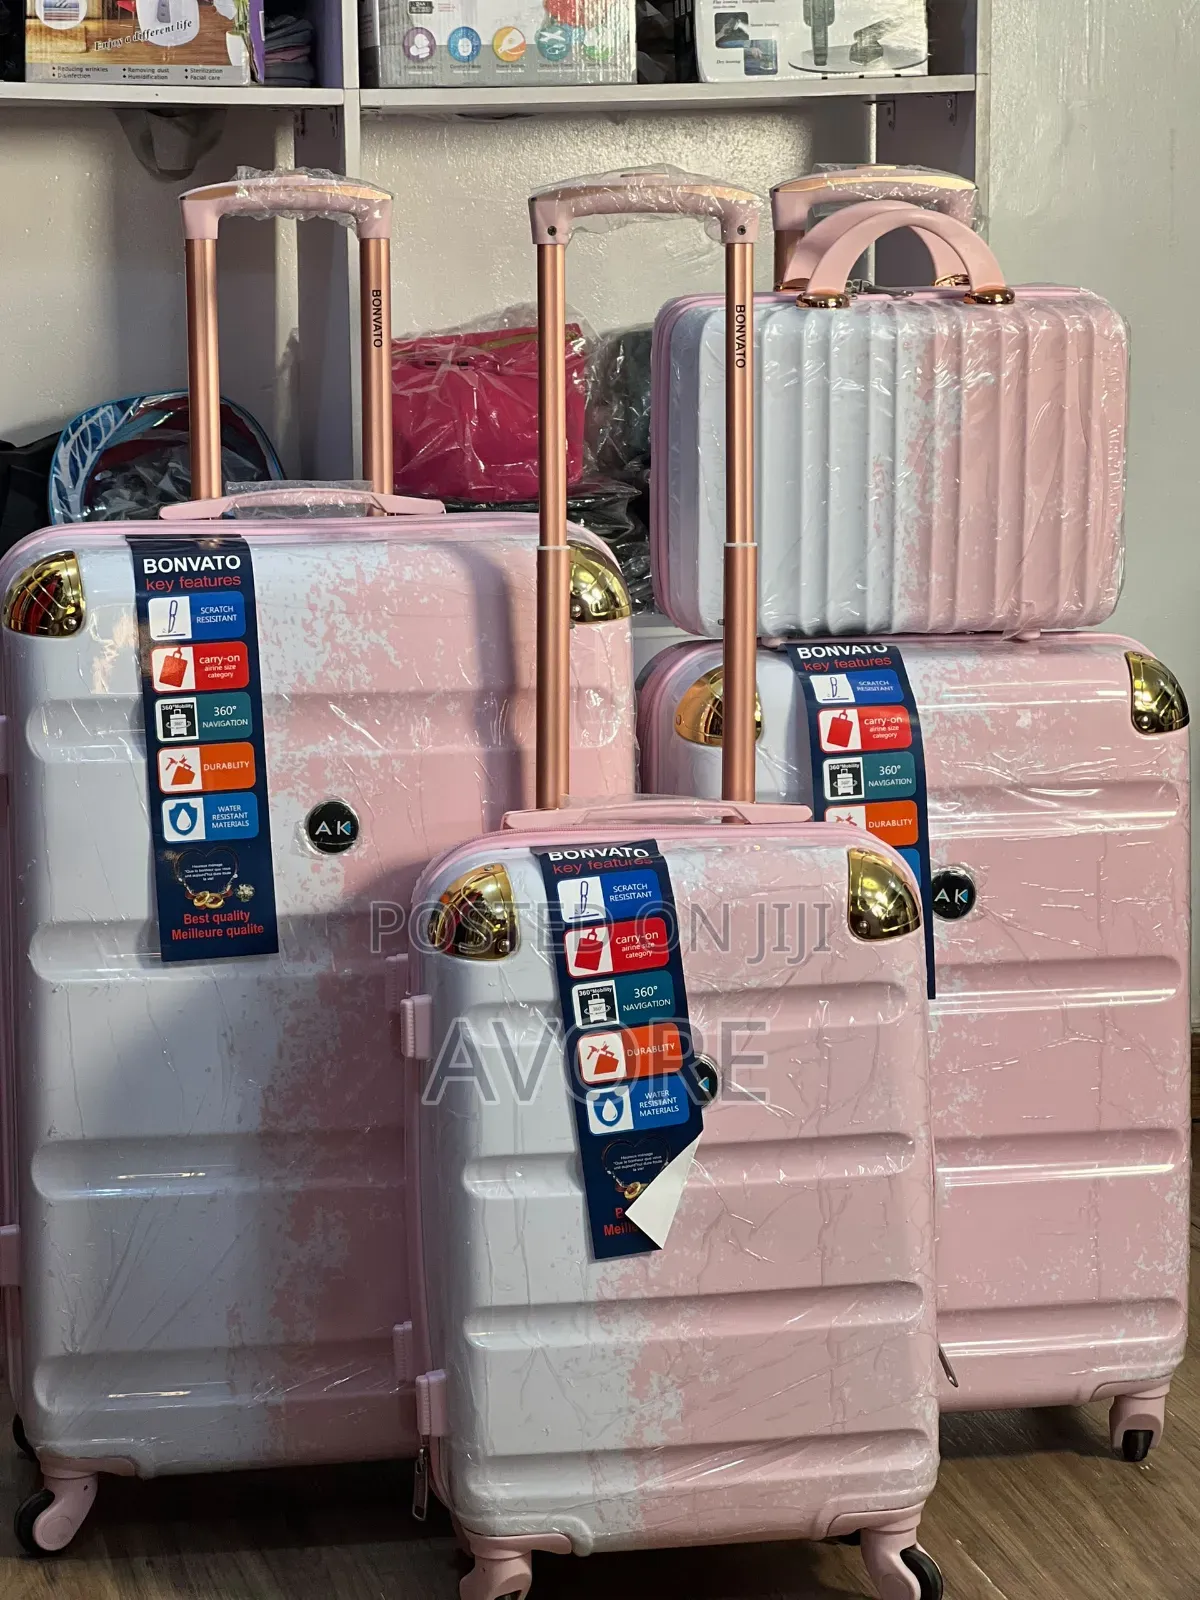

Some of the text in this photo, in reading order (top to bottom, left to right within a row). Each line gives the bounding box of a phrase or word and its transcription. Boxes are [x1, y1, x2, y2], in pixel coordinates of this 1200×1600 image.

[95, 37, 123, 51] Enjoy
[133, 24, 174, 42] different
[176, 20, 193, 31] life
[372, 289, 383, 348] BONVATO
[735, 304, 746, 369] BONVATO
[143, 555, 241, 574] BONVATO
[146, 574, 241, 592] key features
[201, 605, 234, 614] SCRATCH
[196, 614, 238, 624] RESISITANT
[796, 645, 888, 659] BONVATO
[199, 654, 240, 665] carry-on
[803, 656, 892, 672] key features
[207, 671, 234, 680] category
[213, 705, 237, 717] 360°
[202, 719, 249, 729] NAVIGATION
[864, 715, 903, 727] carry-on
[888, 723, 900, 731] size
[872, 731, 898, 740] category
[203, 761, 250, 772] DURABLITY
[879, 765, 901, 776] 360°
[868, 777, 913, 788] NAVIGATION
[217, 804, 242, 813] WATER
[212, 812, 249, 821] RESISTANT
[211, 820, 250, 829] MATERIALS
[868, 819, 913, 829] DURABLITY
[548, 847, 650, 861] BONVATO
[552, 858, 653, 875] key features
[613, 883, 648, 893] SCRATCH
[610, 891, 653, 902] RESISITANT
[183, 910, 250, 925] Best quality
[171, 924, 264, 941] Meilleure qualite
[616, 931, 659, 945] carry-on
[641, 942, 656, 950] size
[626, 950, 653, 960] category
[633, 985, 659, 999] 360°
[623, 998, 671, 1012] NAVIGATION
[627, 1043, 676, 1057] DURABLITY
[644, 1089, 670, 1099] WATER
[639, 1097, 677, 1109] RESISTANT
[639, 1105, 680, 1117] MATERIALS
